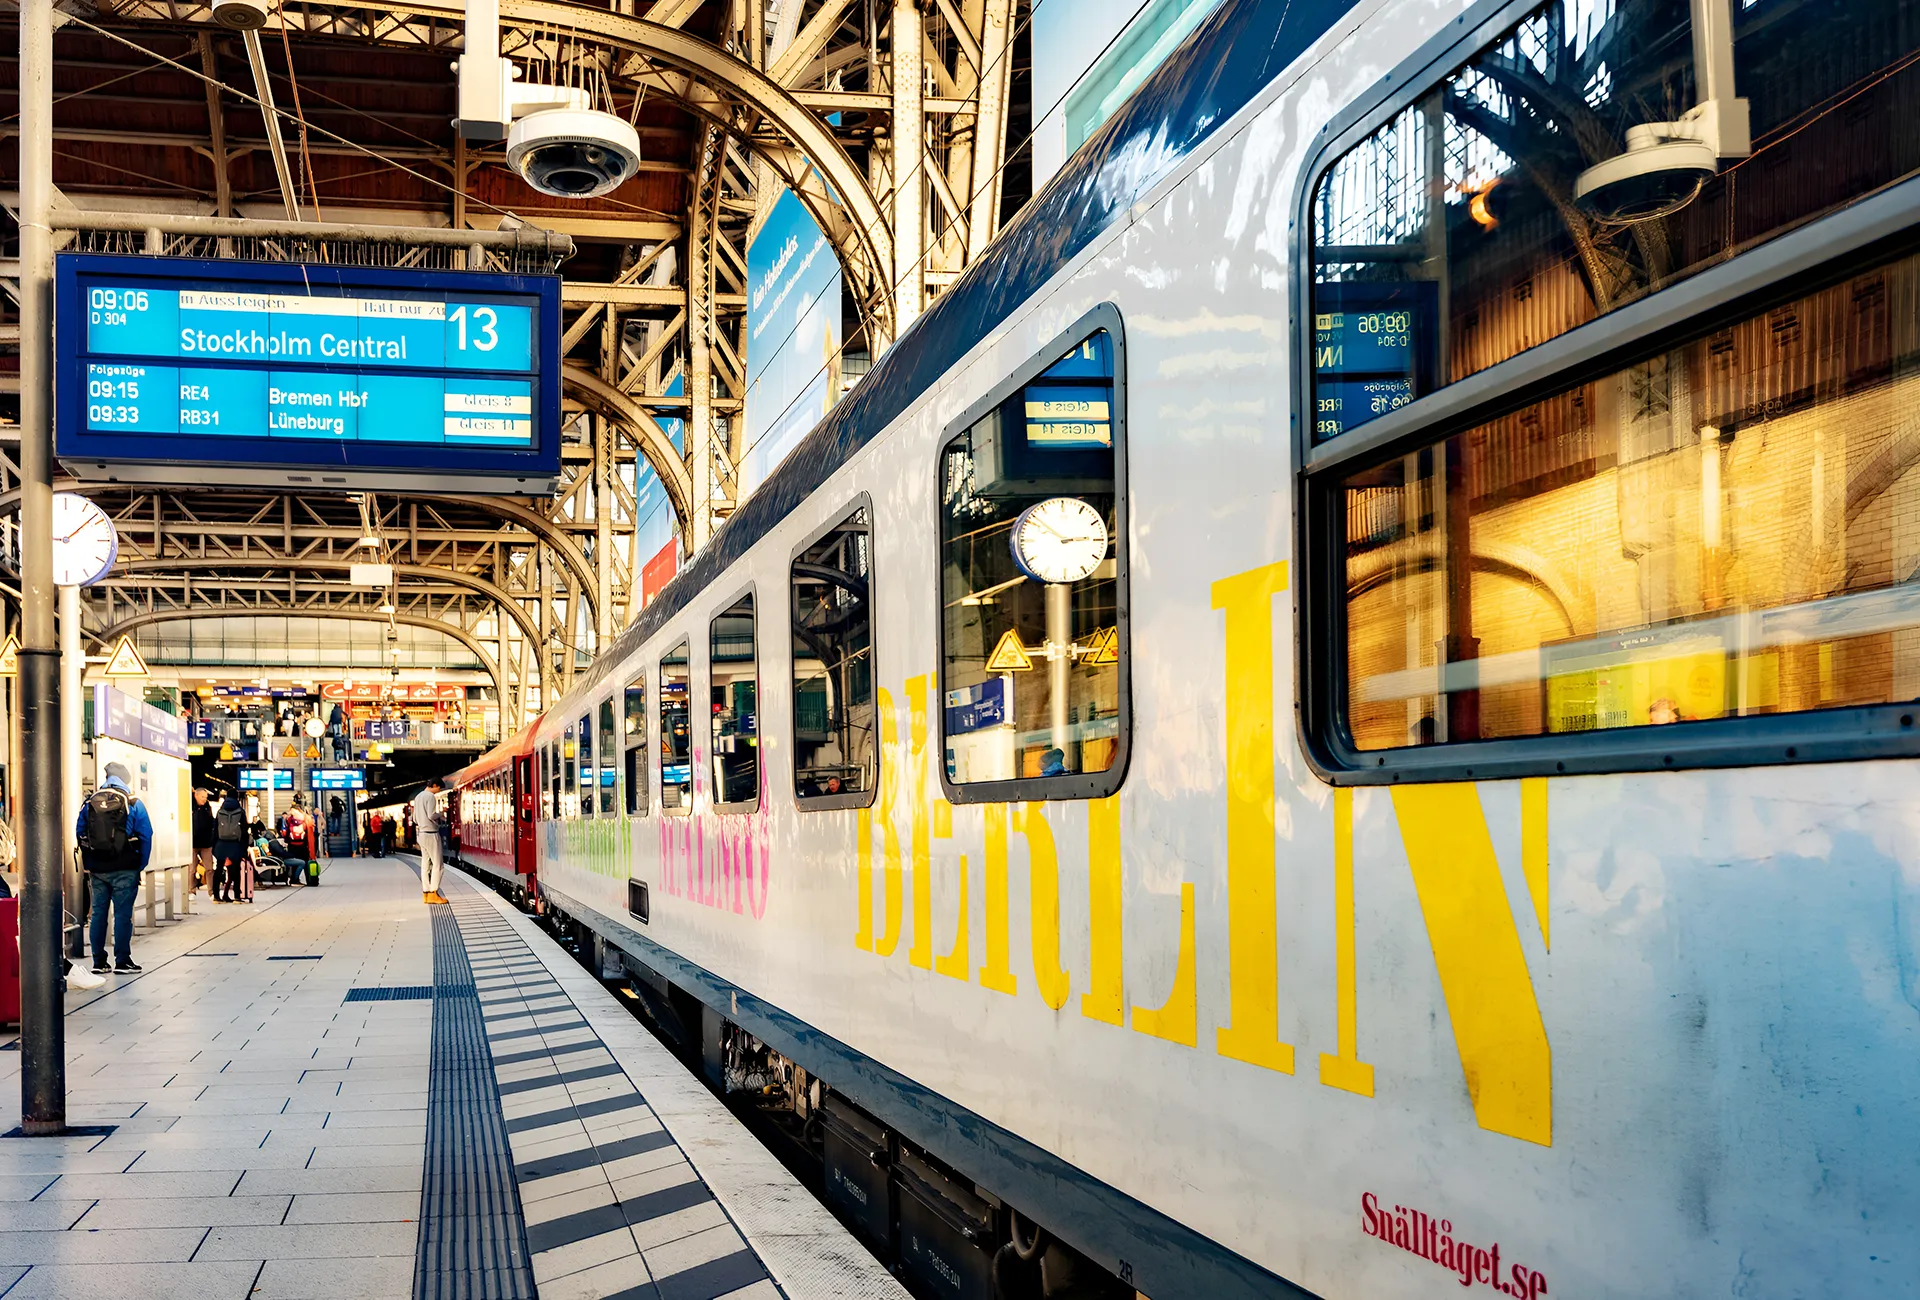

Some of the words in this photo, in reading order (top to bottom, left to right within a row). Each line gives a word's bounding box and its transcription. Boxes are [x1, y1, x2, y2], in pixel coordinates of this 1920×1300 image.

[91, 289, 149, 311] 09:06
[199, 294, 286, 310] Aussteigen
[400, 303, 422, 316] nur
[91, 312, 101, 325] D
[104, 312, 127, 326] 304
[448, 305, 499, 352] 13
[181, 327, 312, 356] Stockholm
[320, 333, 407, 360] Central
[89, 364, 146, 378] Folgezüge
[89, 380, 139, 399] 09:15
[180, 385, 210, 401] RE4
[269, 387, 332, 407] Bremen
[339, 390, 369, 408] Hbf
[464, 394, 500, 408] Gleis
[89, 405, 139, 424] 09:33
[180, 409, 220, 426] RB31
[269, 411, 344, 435] Lüneburg
[459, 418, 495, 431] Gleis
[195, 722, 206, 737] E
[371, 721, 381, 737] E
[388, 720, 404, 735] 13
[854, 560, 1552, 1148] BERLIN
[1361, 1192, 1548, 1300] Snälltåget.se
